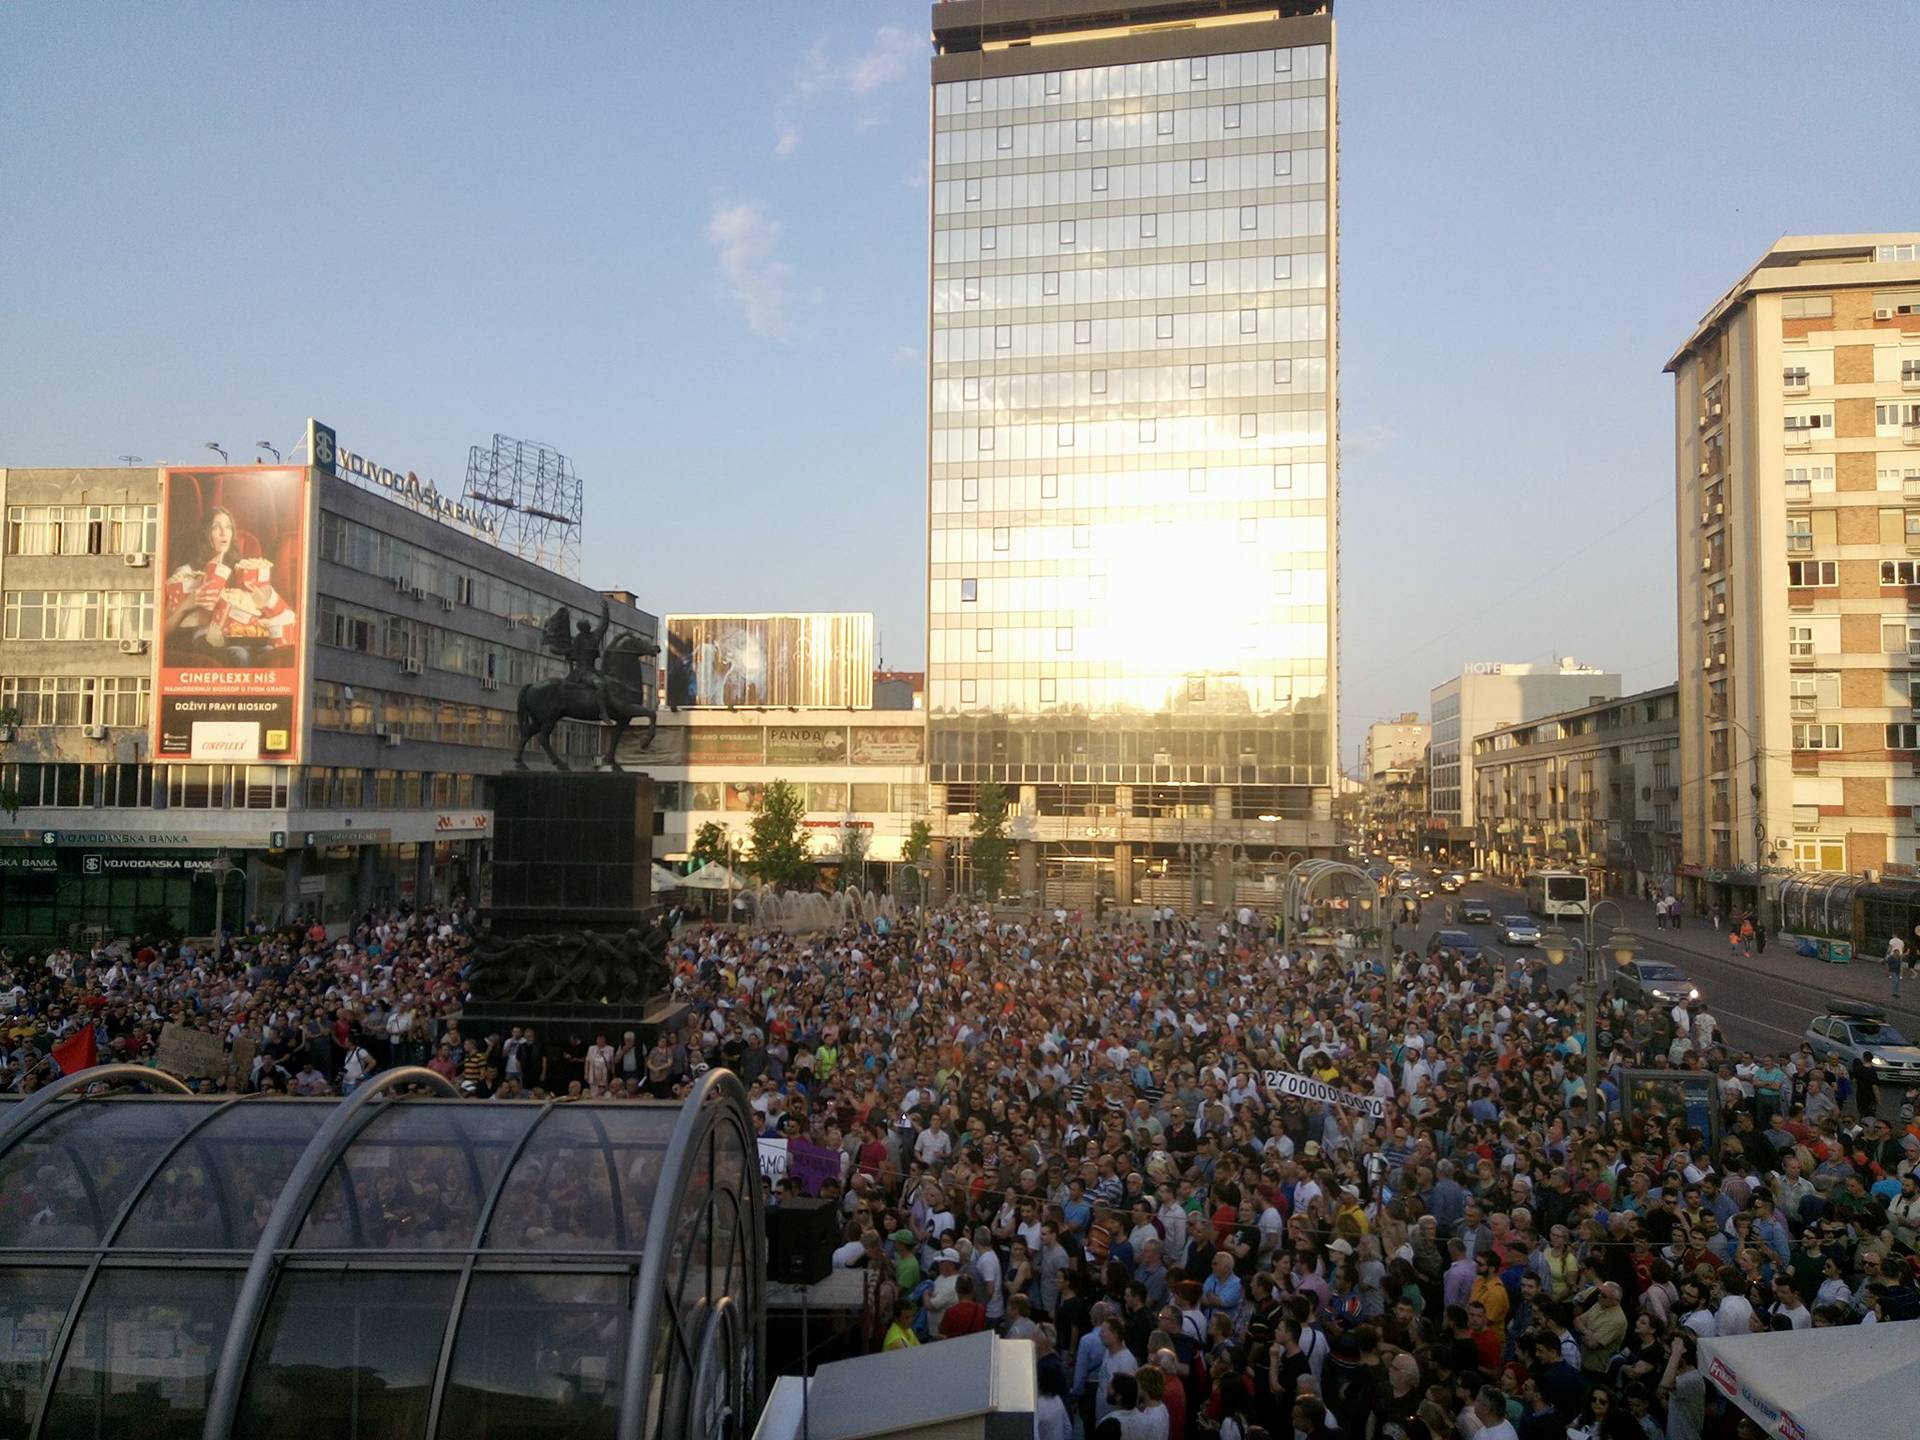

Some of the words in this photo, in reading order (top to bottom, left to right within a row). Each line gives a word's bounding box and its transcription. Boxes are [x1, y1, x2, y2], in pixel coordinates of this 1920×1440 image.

[339, 447, 452, 515] VOJVODANSKA
[453, 500, 496, 536] BANKA
[180, 672, 251, 684] CINEPLEXX
[254, 670, 277, 684] NIŠ
[175, 701, 207, 712] DOŽIVI
[208, 702, 236, 712] PRAVI
[237, 702, 278, 712] BIOSKOP
[770, 729, 822, 741] PANDA
[61, 833, 145, 844] VOJVODANSKA
[149, 833, 189, 844] BANKA
[22, 858, 58, 867] BANKA
[104, 860, 181, 869] VOJVODANSKA
[183, 860, 213, 869] BANK
